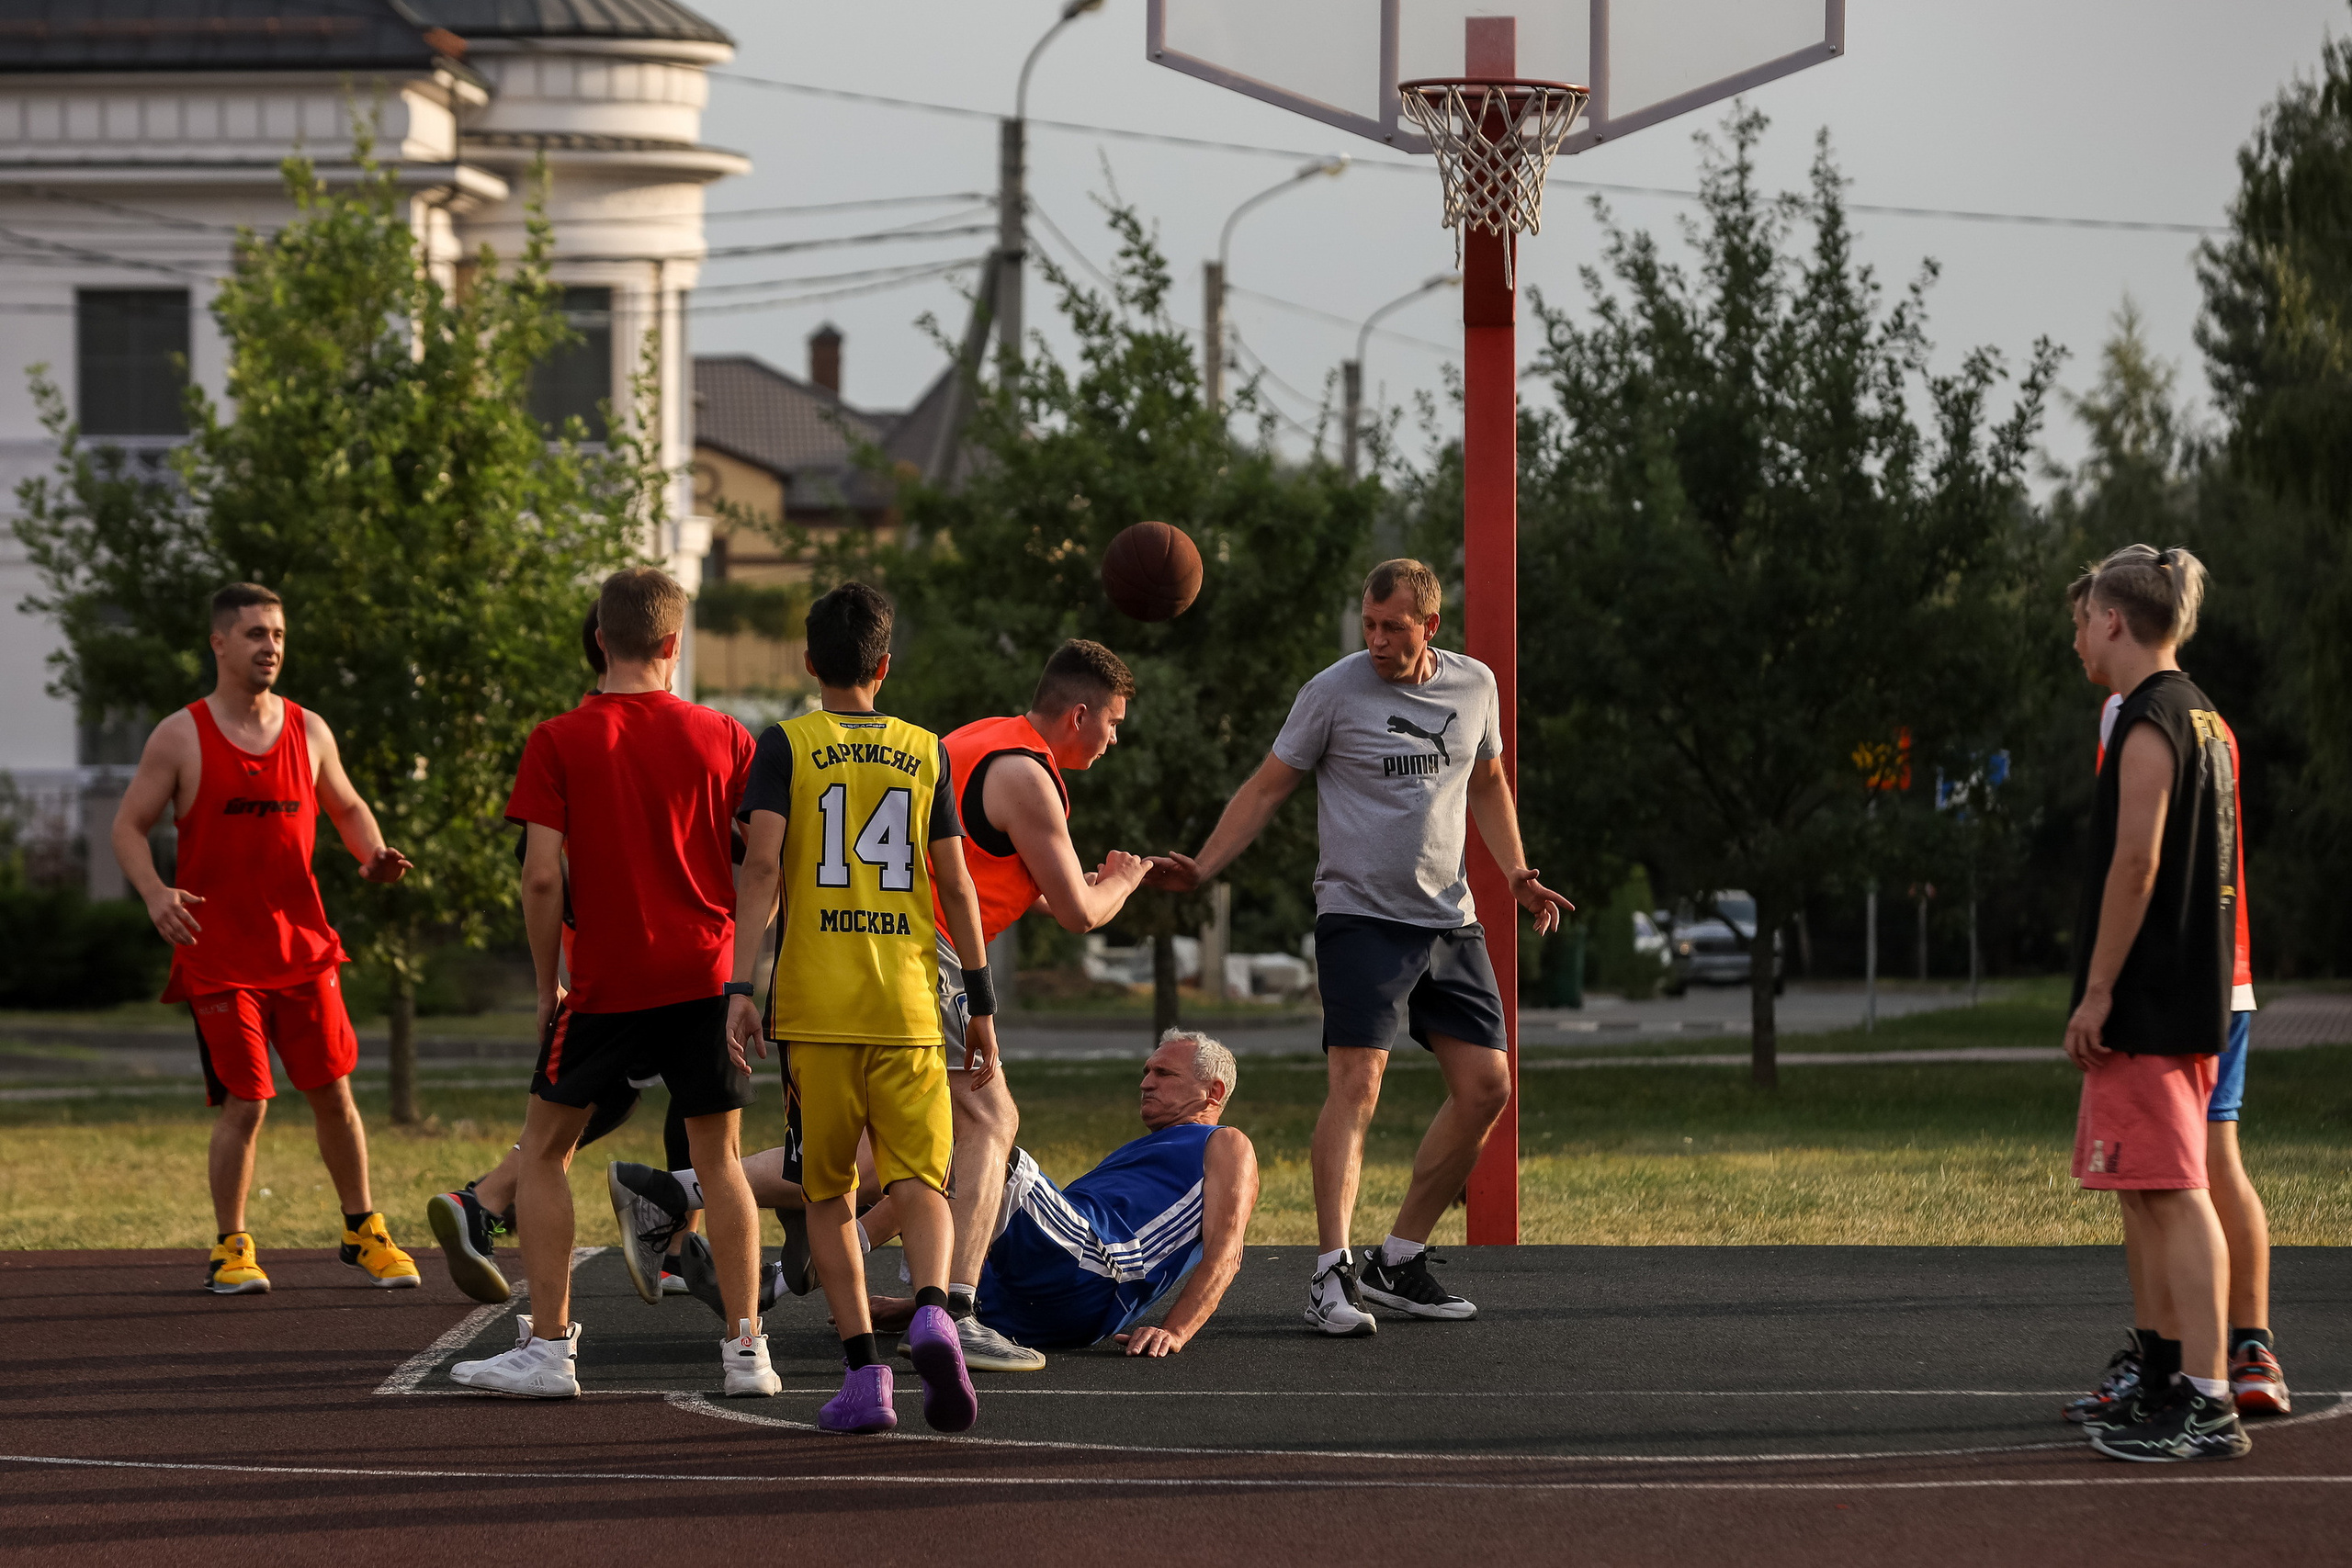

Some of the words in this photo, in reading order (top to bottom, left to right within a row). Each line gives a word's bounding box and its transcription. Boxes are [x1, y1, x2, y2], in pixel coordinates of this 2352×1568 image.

[811, 742, 922, 777] САРКИСЯН
[1383, 753, 1440, 777] PUMA
[816, 783, 914, 893] 14
[820, 908, 911, 935] МОСКВА
